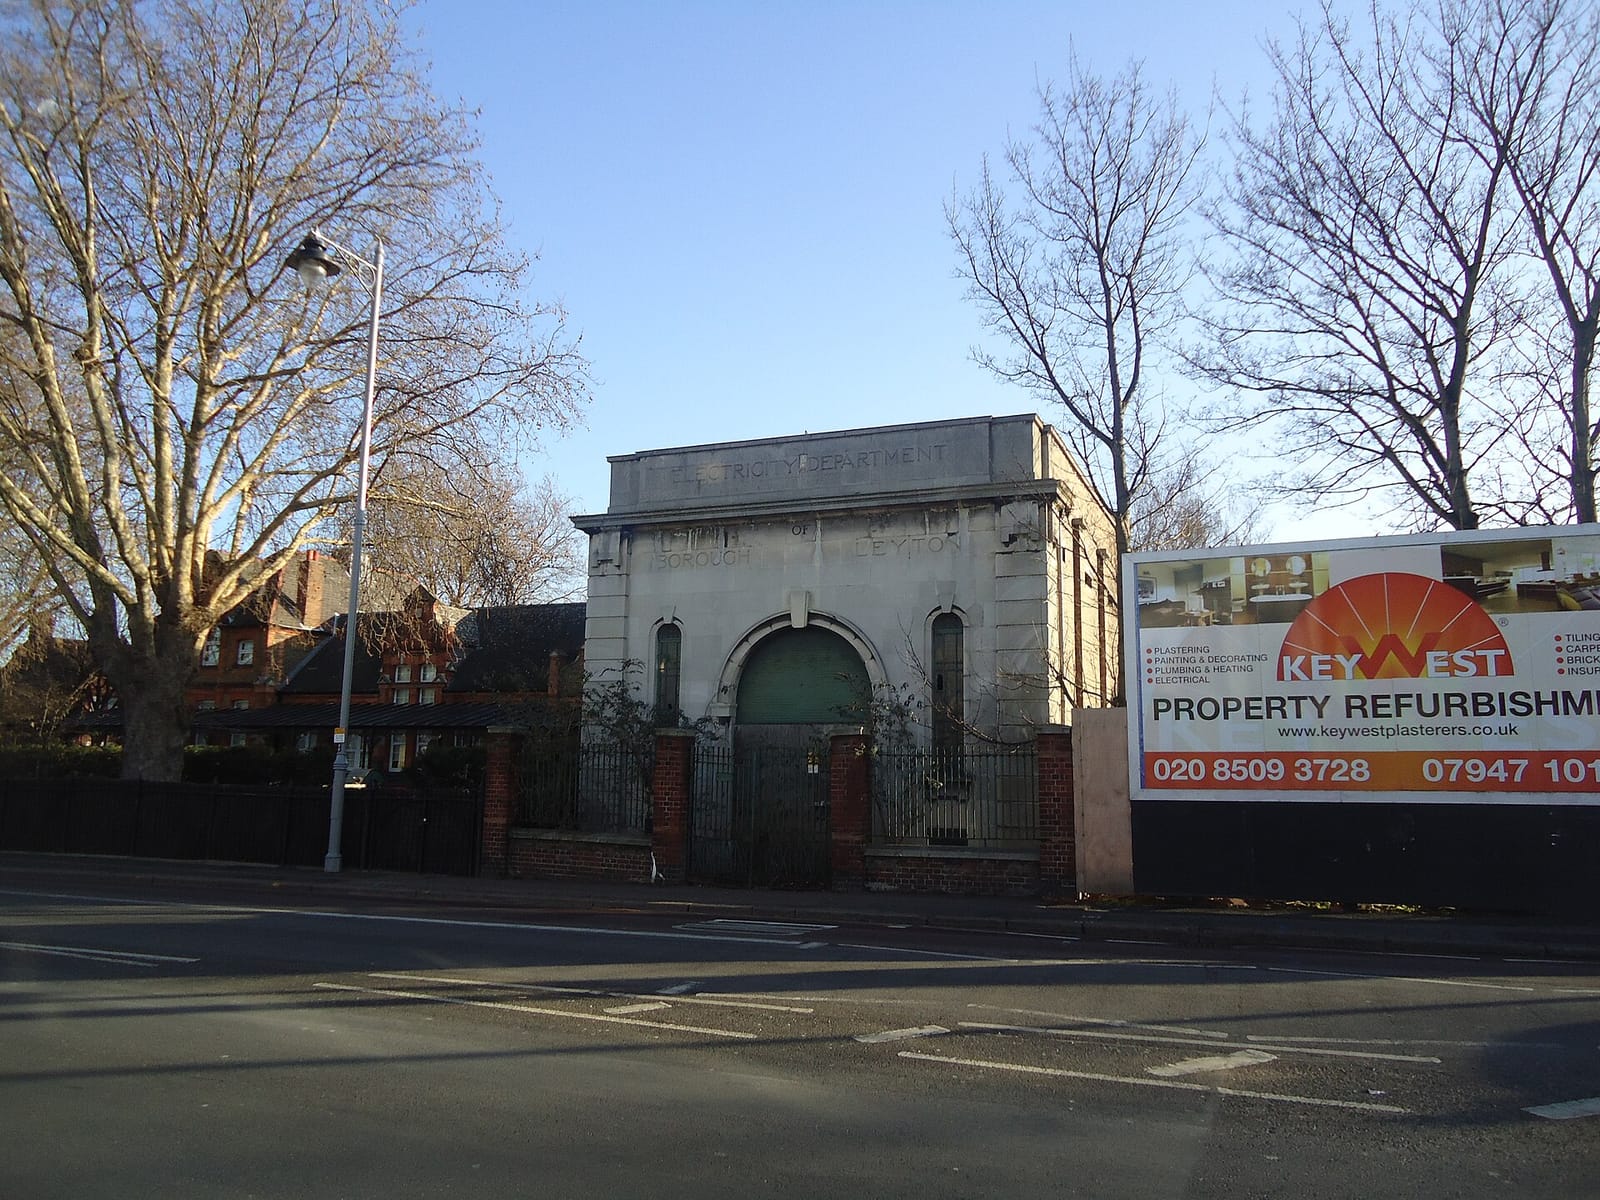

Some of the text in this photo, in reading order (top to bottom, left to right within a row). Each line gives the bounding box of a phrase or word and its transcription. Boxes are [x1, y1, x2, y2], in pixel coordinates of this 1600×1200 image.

[671, 444, 949, 484] ELECTRICITY DEPARTMENT
[657, 549, 750, 570] BOROUGH
[855, 535, 961, 557] LEYTON
[1565, 633, 1600, 642] TILING
[1154, 645, 1210, 655] PLASTERING
[1154, 653, 1268, 665] PAINTING & DECORATING
[1155, 664, 1254, 675] PLUMBING & HEATING
[1155, 675, 1210, 685] ELECTRICAL
[1152, 690, 1600, 721] PROPERTY REFURBISHM
[1278, 722, 1519, 739] www.keywestplasterers.co.uk
[1153, 758, 1206, 781] 020
[1212, 758, 1286, 782] 8509
[1294, 758, 1371, 782] 3728
[1422, 758, 1529, 783] 07947
